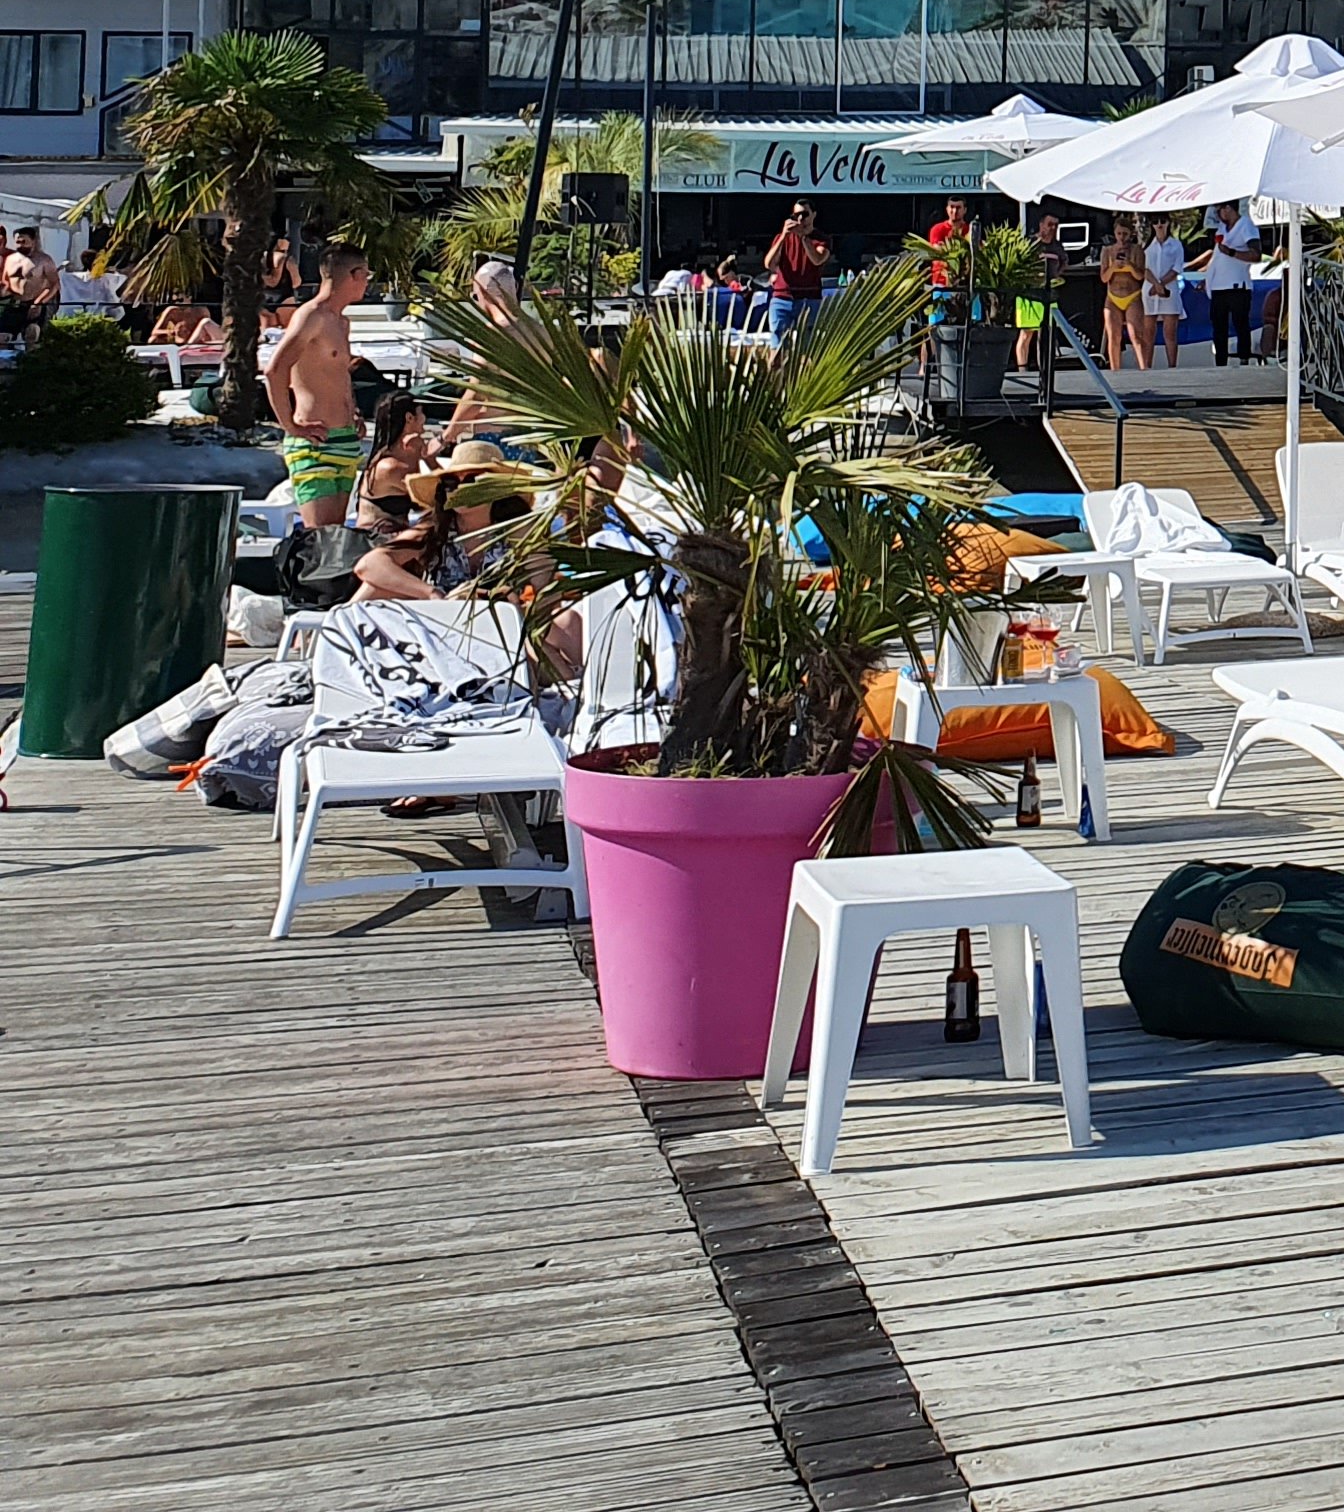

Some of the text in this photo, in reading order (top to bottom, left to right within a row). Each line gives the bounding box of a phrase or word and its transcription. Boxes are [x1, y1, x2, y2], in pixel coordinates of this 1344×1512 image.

[735, 141, 888, 188] La Vella
[683, 173, 727, 187] CLUB
[1102, 181, 1208, 205] La Vella
